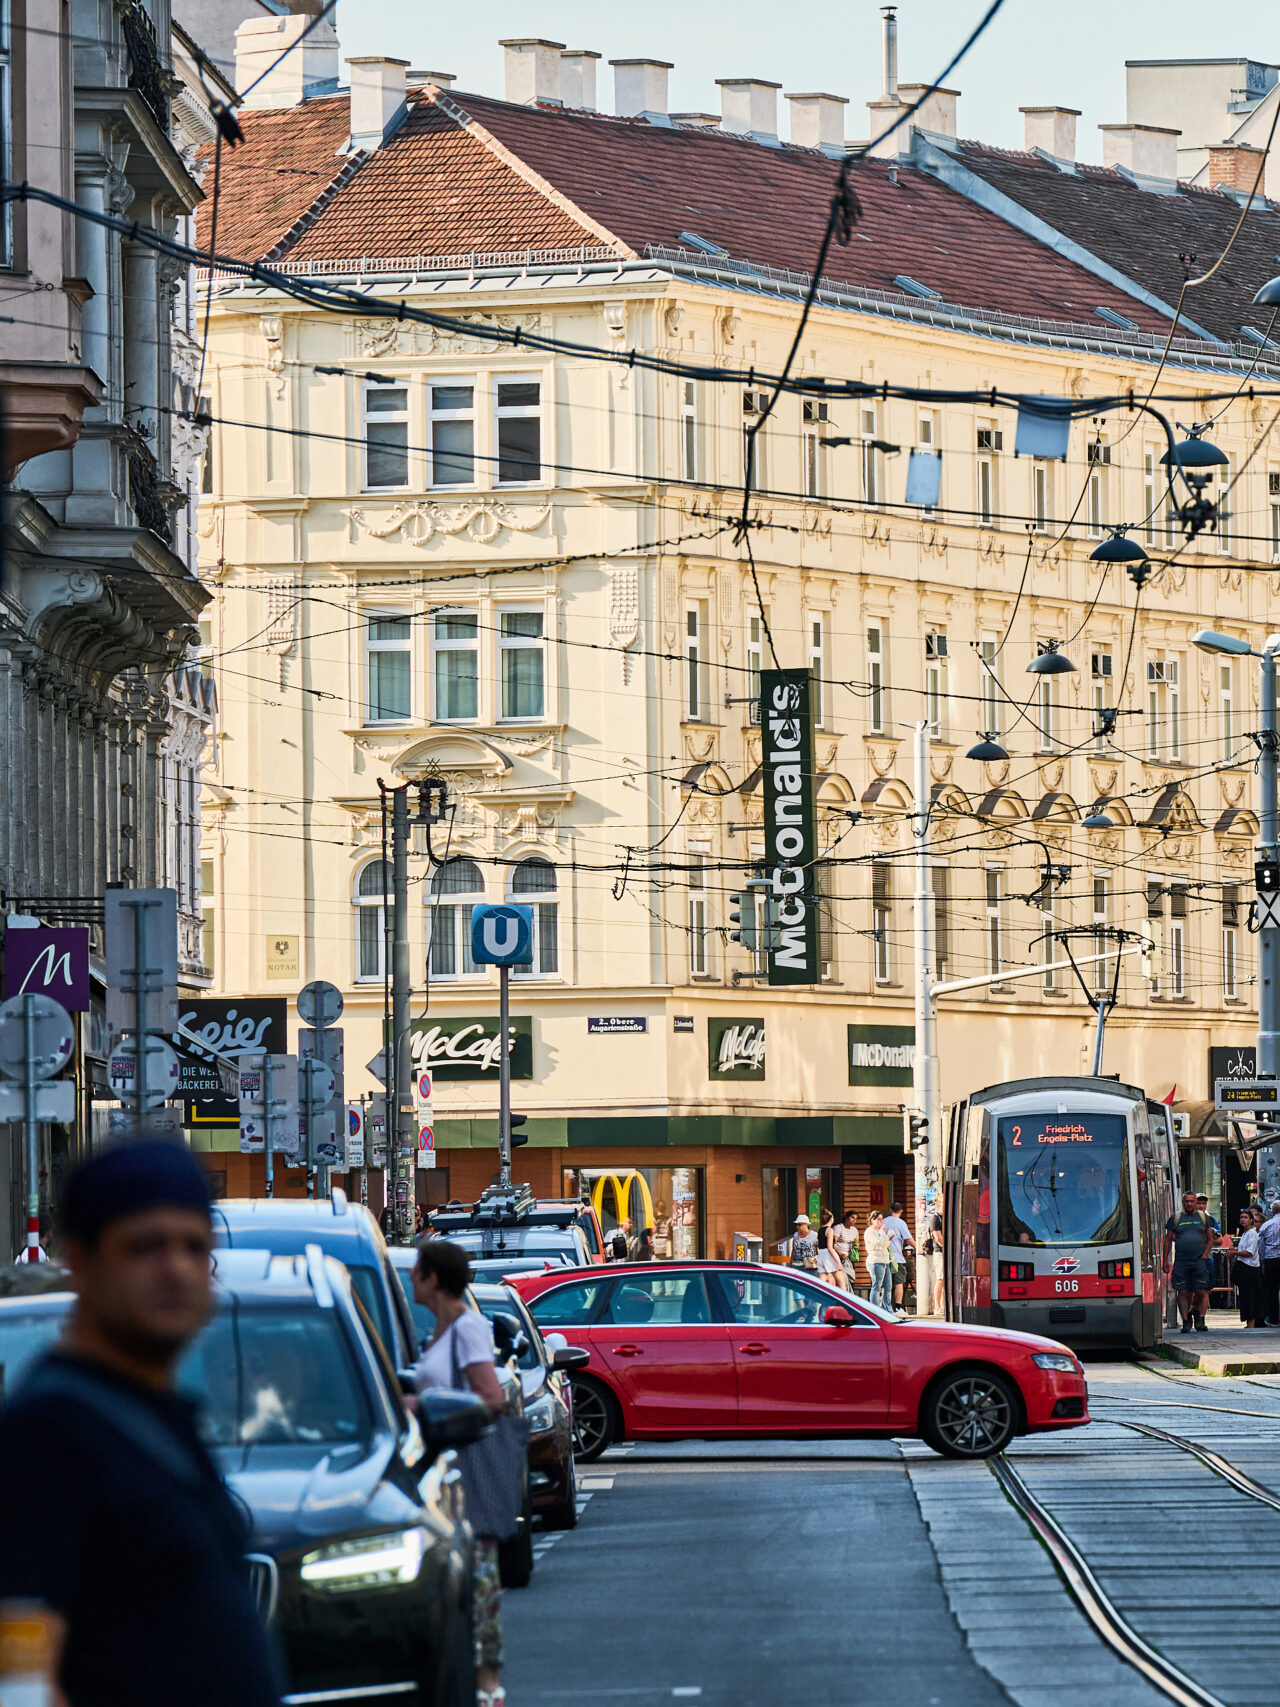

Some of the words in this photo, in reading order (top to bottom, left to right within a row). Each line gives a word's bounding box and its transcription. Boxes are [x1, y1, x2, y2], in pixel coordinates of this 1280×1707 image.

[769, 684, 807, 970] McDonald's
[483, 918, 519, 957] U
[182, 1067, 197, 1076] DIE
[177, 1079, 218, 1090] BÄCKEREI
[1012, 1126, 1022, 1146] 2
[1046, 1124, 1085, 1133] Friedrich
[1037, 1134, 1093, 1143] Engels-Platz
[737, 1244, 745, 1261] e24
[1055, 1280, 1079, 1292] 606
